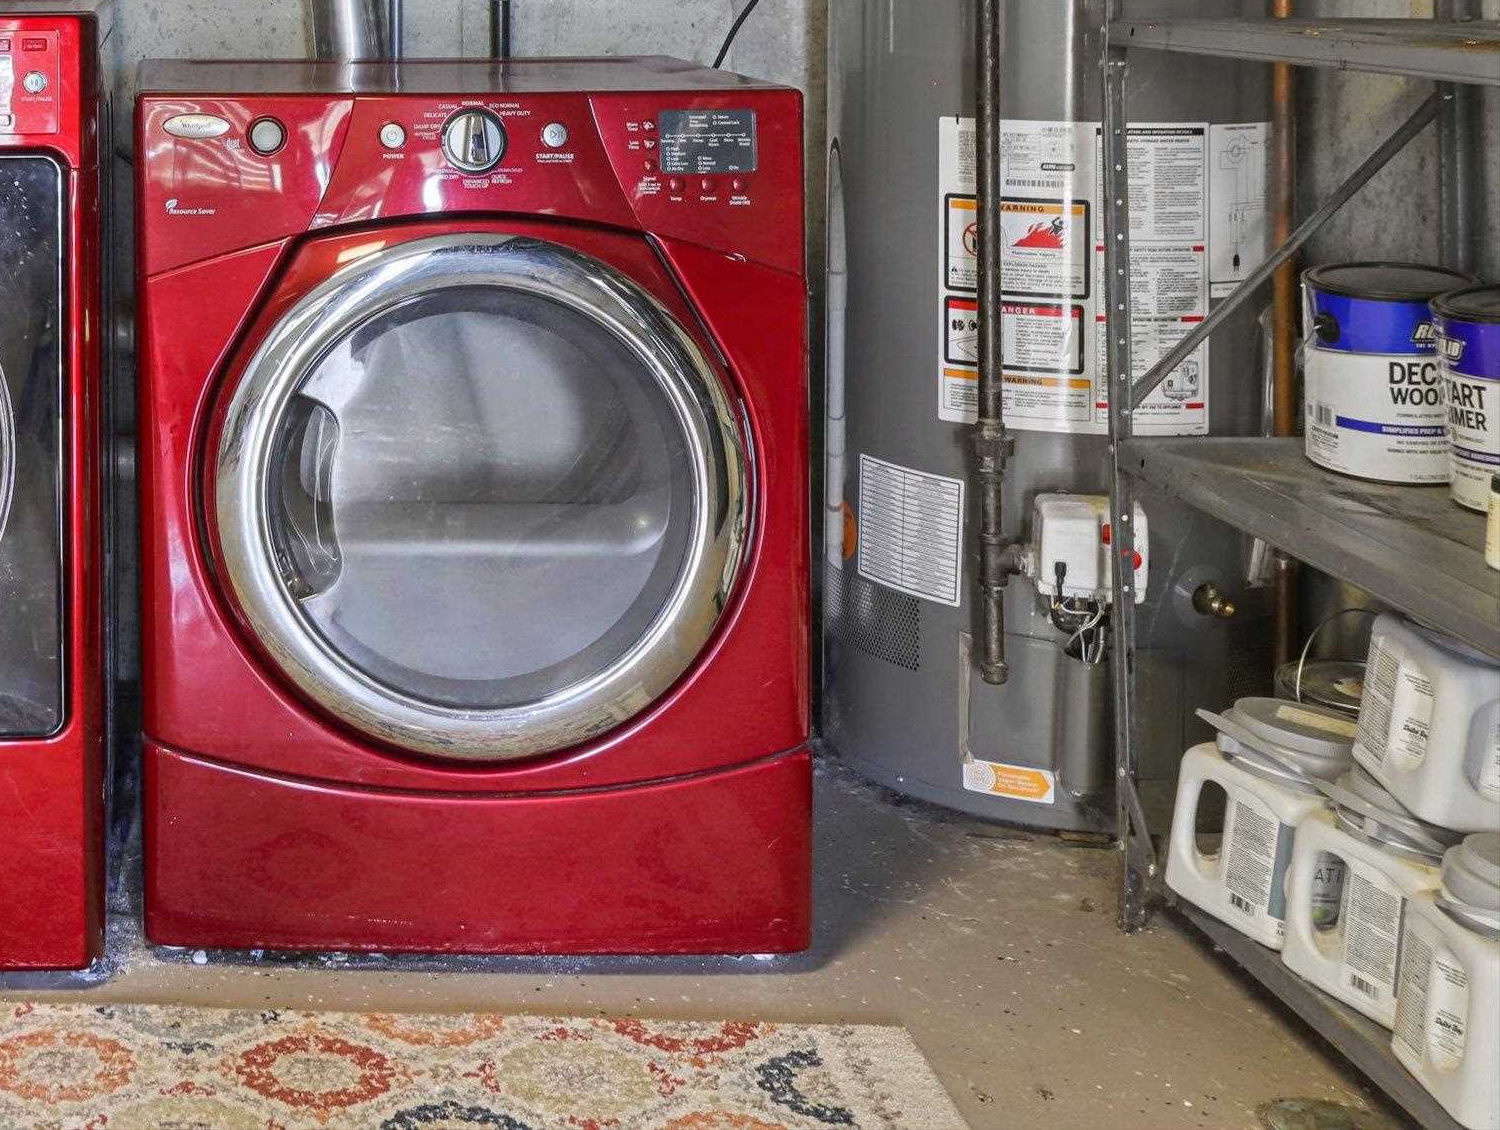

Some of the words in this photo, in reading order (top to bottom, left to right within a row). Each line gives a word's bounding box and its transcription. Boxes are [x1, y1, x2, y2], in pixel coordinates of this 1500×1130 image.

[169, 207, 197, 215] Resource
[1002, 305, 1035, 315] ANGER
[1389, 362, 1438, 385] DEC
[1004, 376, 1043, 386] WARNING
